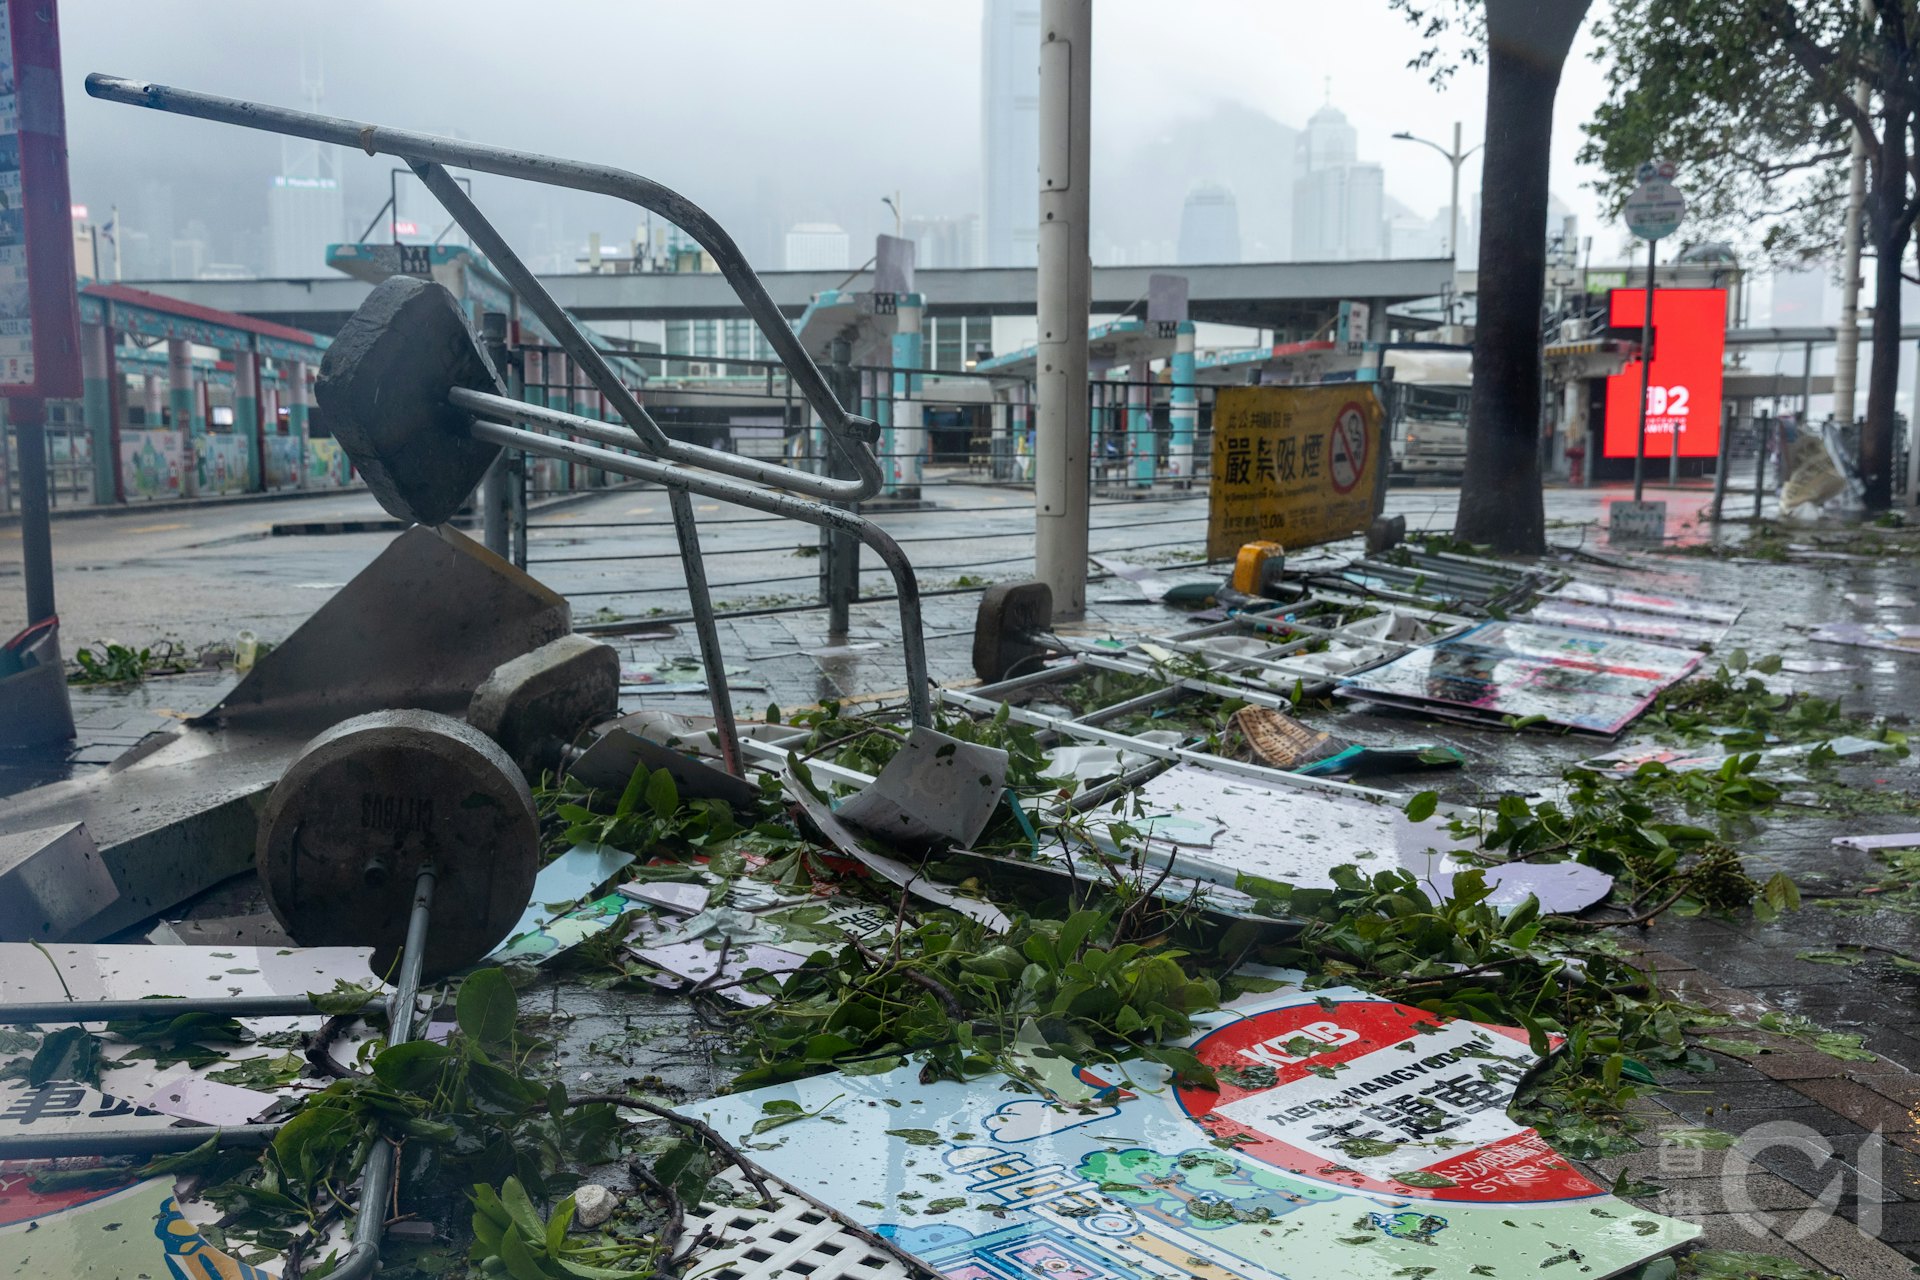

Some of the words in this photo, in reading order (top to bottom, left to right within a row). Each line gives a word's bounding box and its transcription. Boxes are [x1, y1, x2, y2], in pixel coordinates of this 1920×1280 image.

[405, 247, 427, 258] YT
[403, 259, 428, 273] 913
[361, 792, 434, 831] CITYBUS
[1470, 1164, 1548, 1194] STAR
